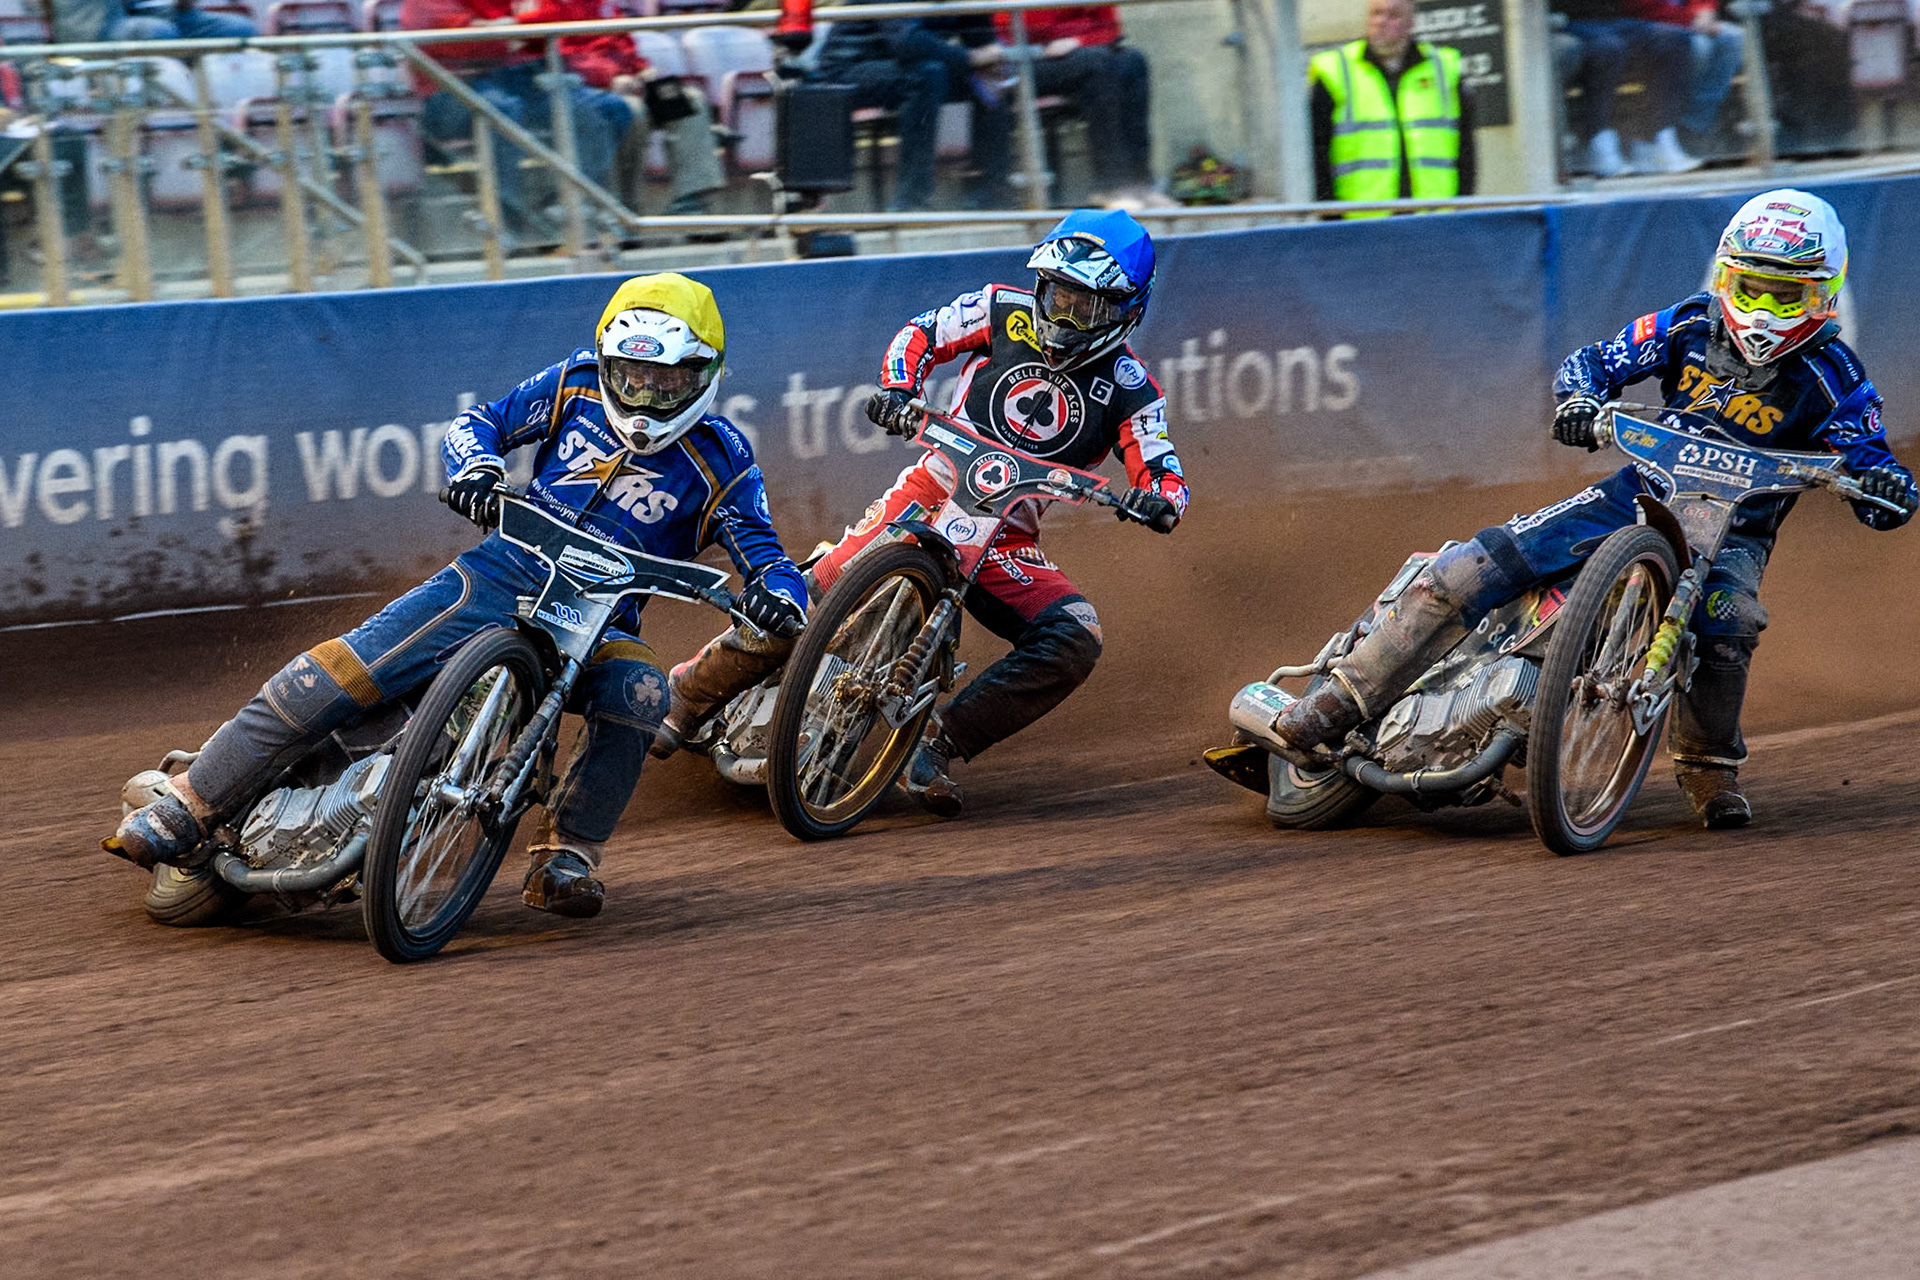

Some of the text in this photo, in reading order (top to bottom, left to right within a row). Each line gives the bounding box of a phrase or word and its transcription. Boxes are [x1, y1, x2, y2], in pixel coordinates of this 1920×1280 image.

[1121, 362, 1140, 383] ATPI
[1007, 368, 1080, 424] BELLE VUE ACES
[575, 414, 598, 434] KING'S
[976, 454, 996, 467] BELLE
[997, 454, 1011, 464] VUE
[1700, 446, 1759, 477] PSH
[951, 523, 972, 536] ATPI
